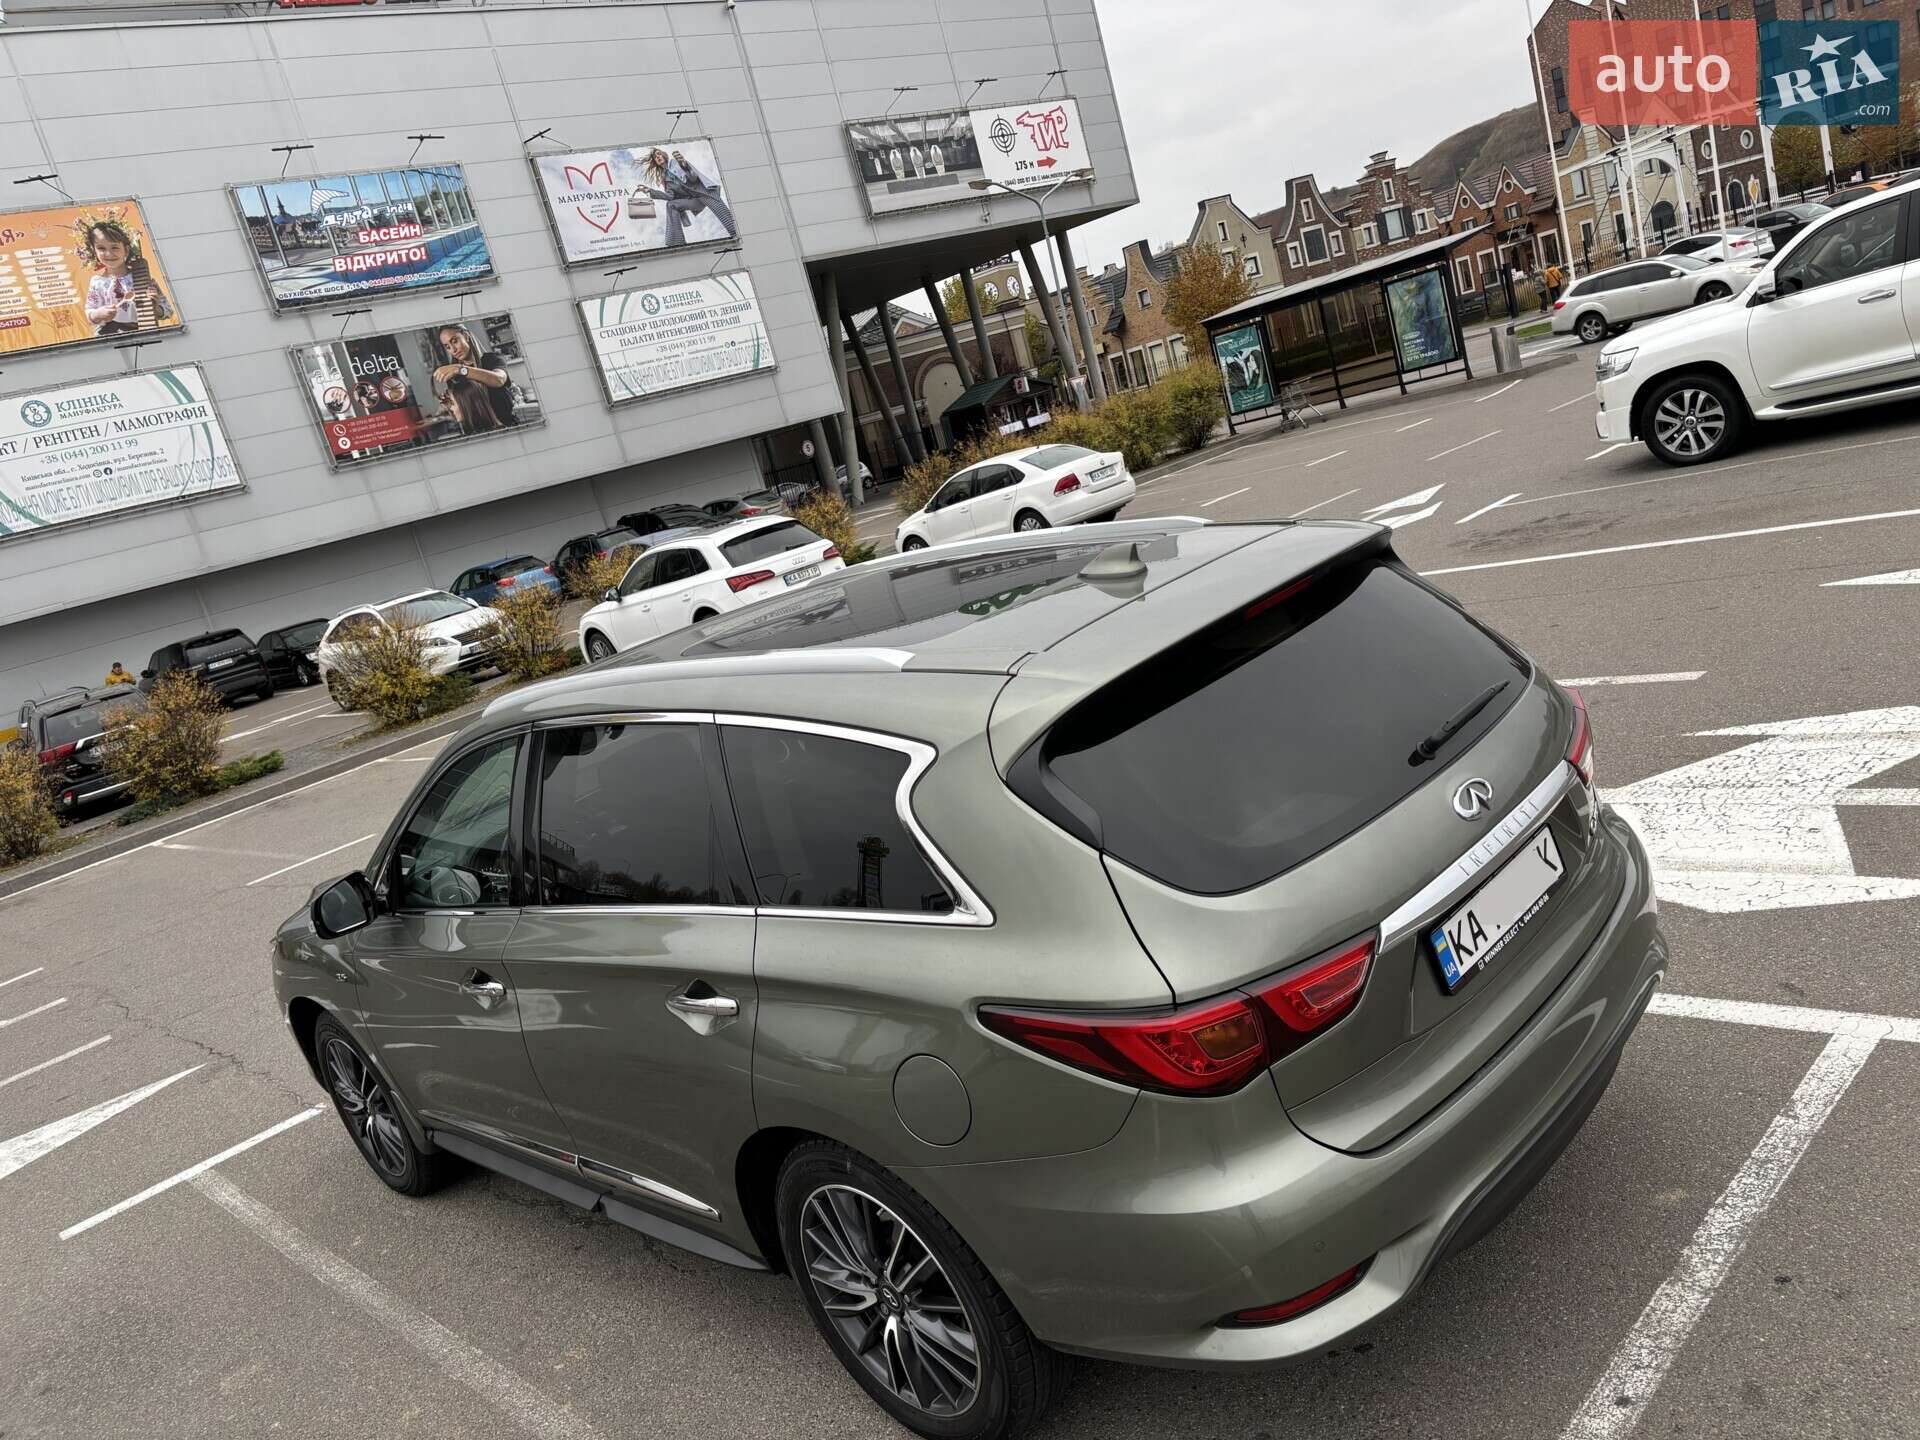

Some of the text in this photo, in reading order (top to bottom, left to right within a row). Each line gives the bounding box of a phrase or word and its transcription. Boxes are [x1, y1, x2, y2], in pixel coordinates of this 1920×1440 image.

[1016, 105, 1069, 151] ТИР
[1015, 160, 1028, 170] 175
[558, 188, 630, 204] МАНУФАКТУРА
[358, 224, 421, 243] БАСЕЙН
[334, 247, 427, 272] ВІДКРИТО!
[278, 287, 323, 300] ОБУХІВСЬКЕ
[324, 285, 345, 293] ШОСЕ
[662, 290, 702, 305] КЛІНІКА
[600, 302, 752, 339] СТАЦІОНАР ЦІЛОДОБОВИЙ ТА ДЕННИЙ
[619, 316, 741, 348] ПАЛАТИ ІНТЕНСИВНОЇ ТЕРАПІЇ
[668, 342, 686, 354] (044)
[686, 340, 698, 348] 200
[350, 354, 400, 377] delta
[55, 392, 121, 413] КЛІНІКА
[59, 402, 124, 420] МАНУФАКТУРА
[23, 437, 28, 453] /
[33, 424, 101, 449] РЕНТГЕН
[104, 421, 110, 437] /
[113, 405, 208, 433] МАМОГРАФІЯ
[40, 439, 138, 465] +38 (044) 200 11 99
[1483, 940, 1505, 963] WINNER
[1503, 923, 1520, 944] SELECT
[1444, 962, 1457, 978] UA
